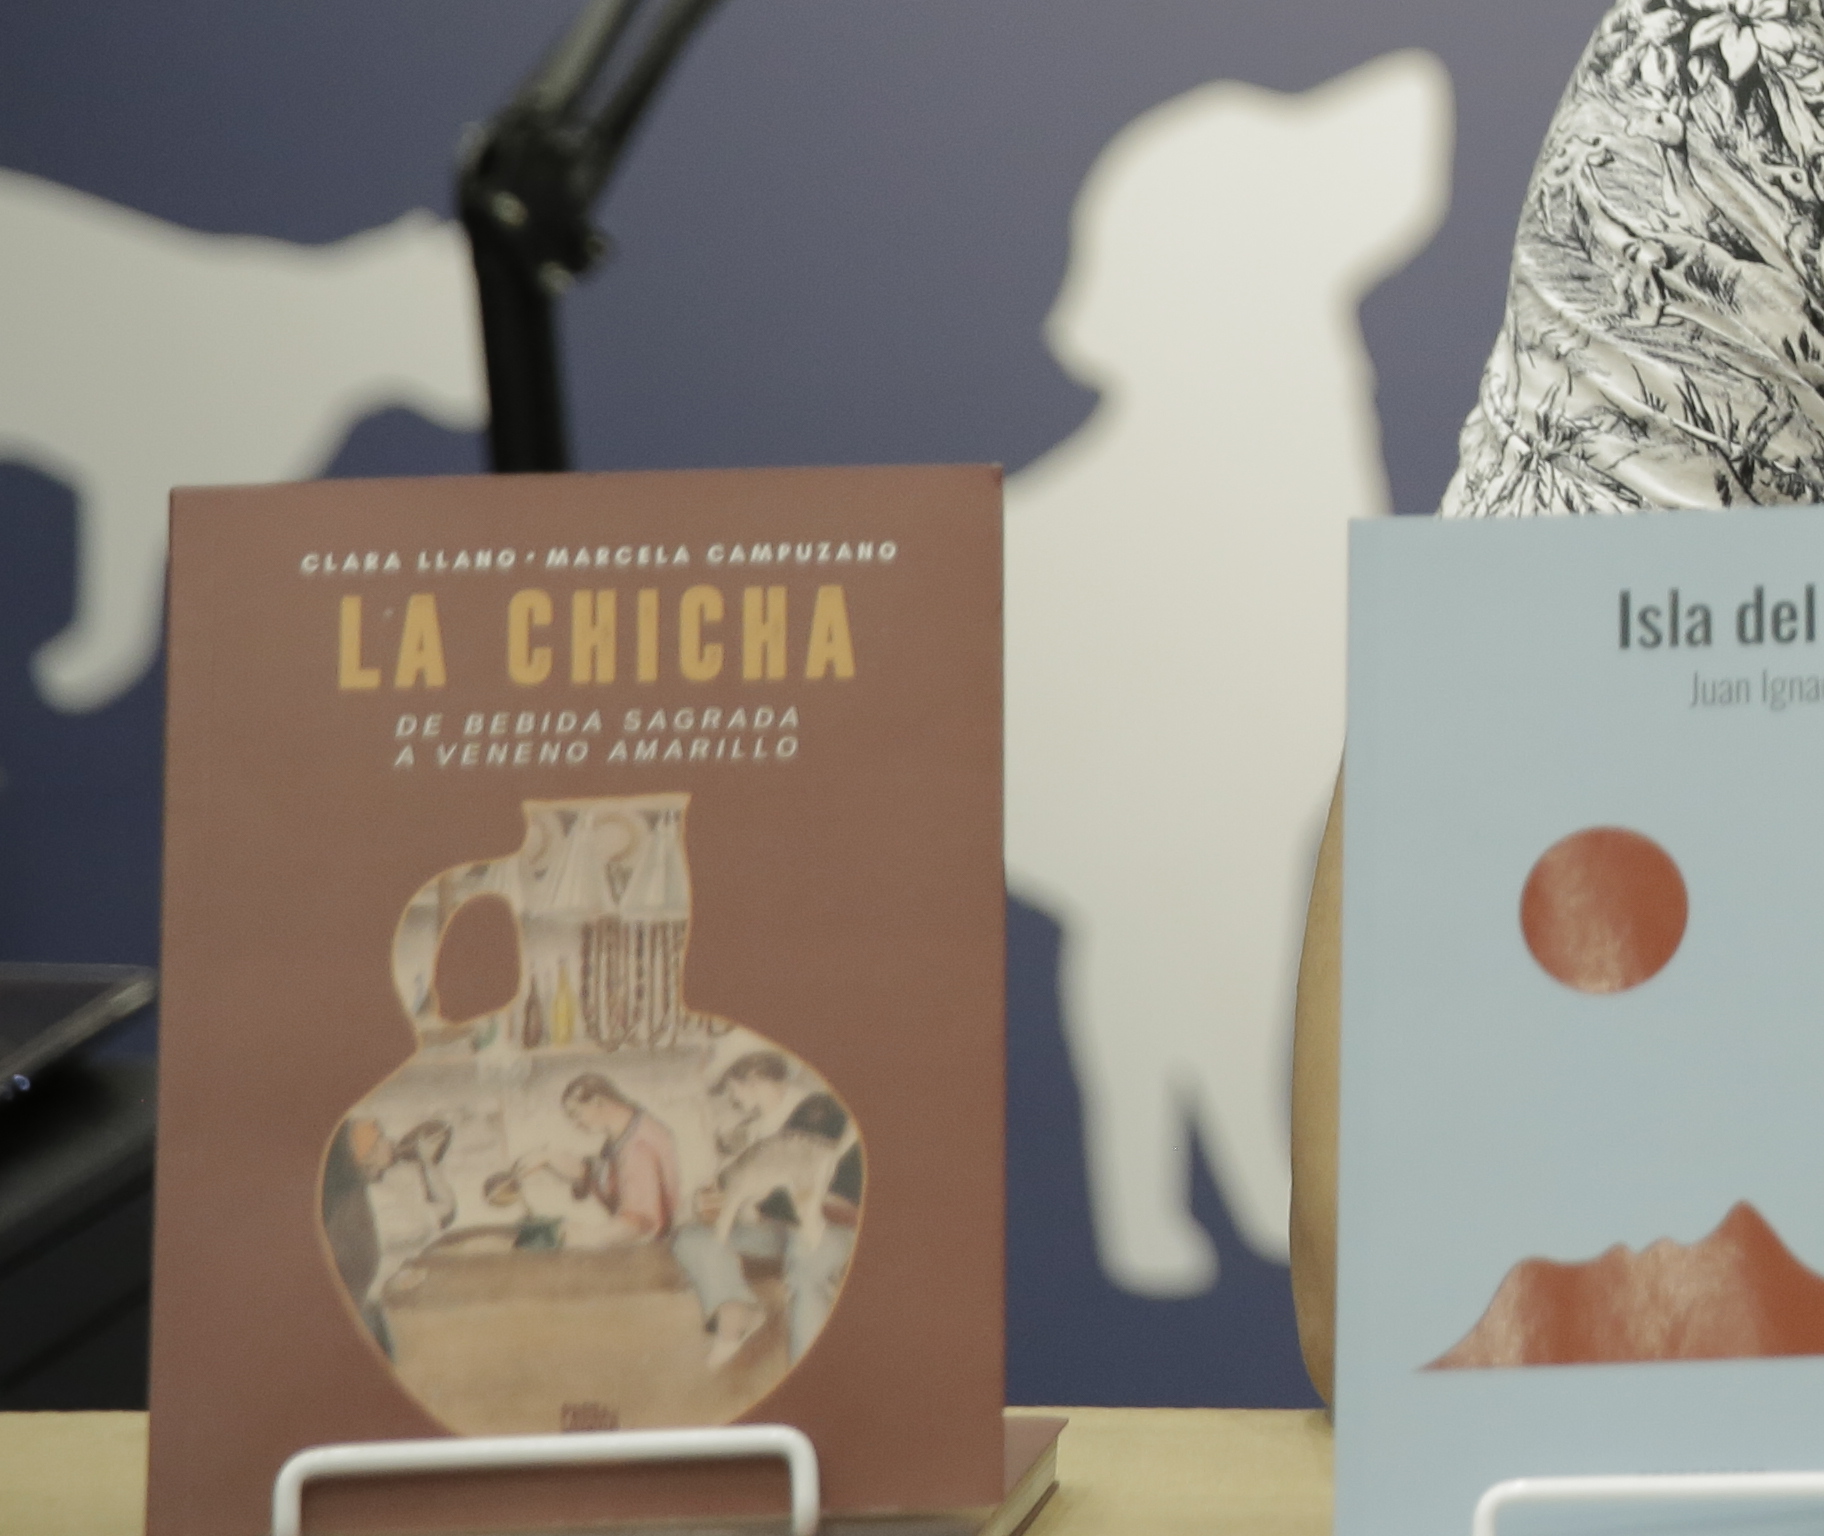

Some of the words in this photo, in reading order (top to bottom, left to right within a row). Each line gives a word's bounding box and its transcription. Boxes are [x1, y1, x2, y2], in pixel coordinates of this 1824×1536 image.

[300, 551, 402, 575] CLARA
[417, 548, 517, 571] LLANO
[545, 544, 691, 569] MARCELA
[706, 539, 899, 564] CAMPUZANO
[1618, 586, 1713, 650] Isla
[1735, 582, 1817, 646] del
[338, 591, 448, 690] LA
[506, 583, 856, 686] CHICHA
[1690, 669, 1751, 709] Juan
[394, 712, 443, 739] DE
[462, 708, 603, 736] BEBIDA
[622, 705, 800, 734] SAGRADA
[394, 744, 416, 768] A
[435, 739, 590, 767] VENENO
[606, 735, 799, 762] AMARILLO
